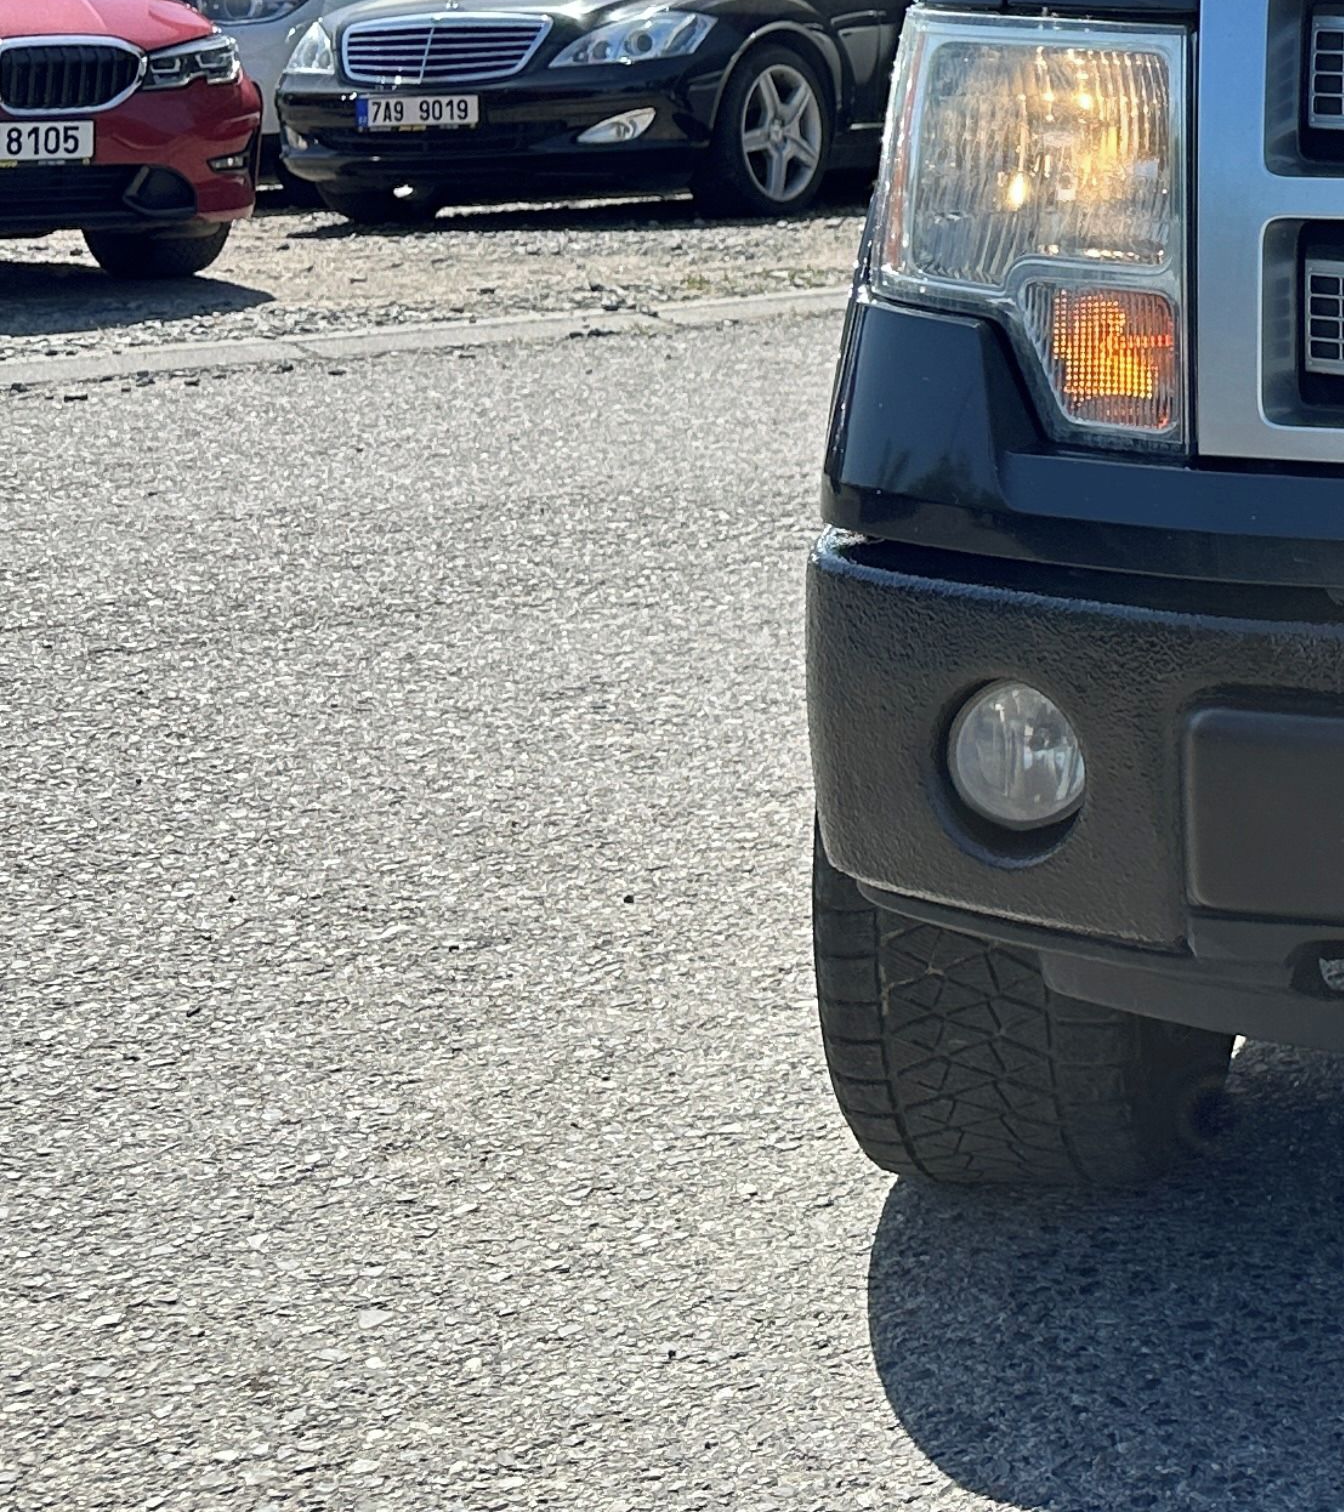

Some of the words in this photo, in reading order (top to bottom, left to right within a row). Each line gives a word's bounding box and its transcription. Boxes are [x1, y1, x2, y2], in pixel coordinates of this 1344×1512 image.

[371, 101, 404, 123] 7A9
[419, 99, 468, 121] 9019
[6, 126, 80, 155] 8105
